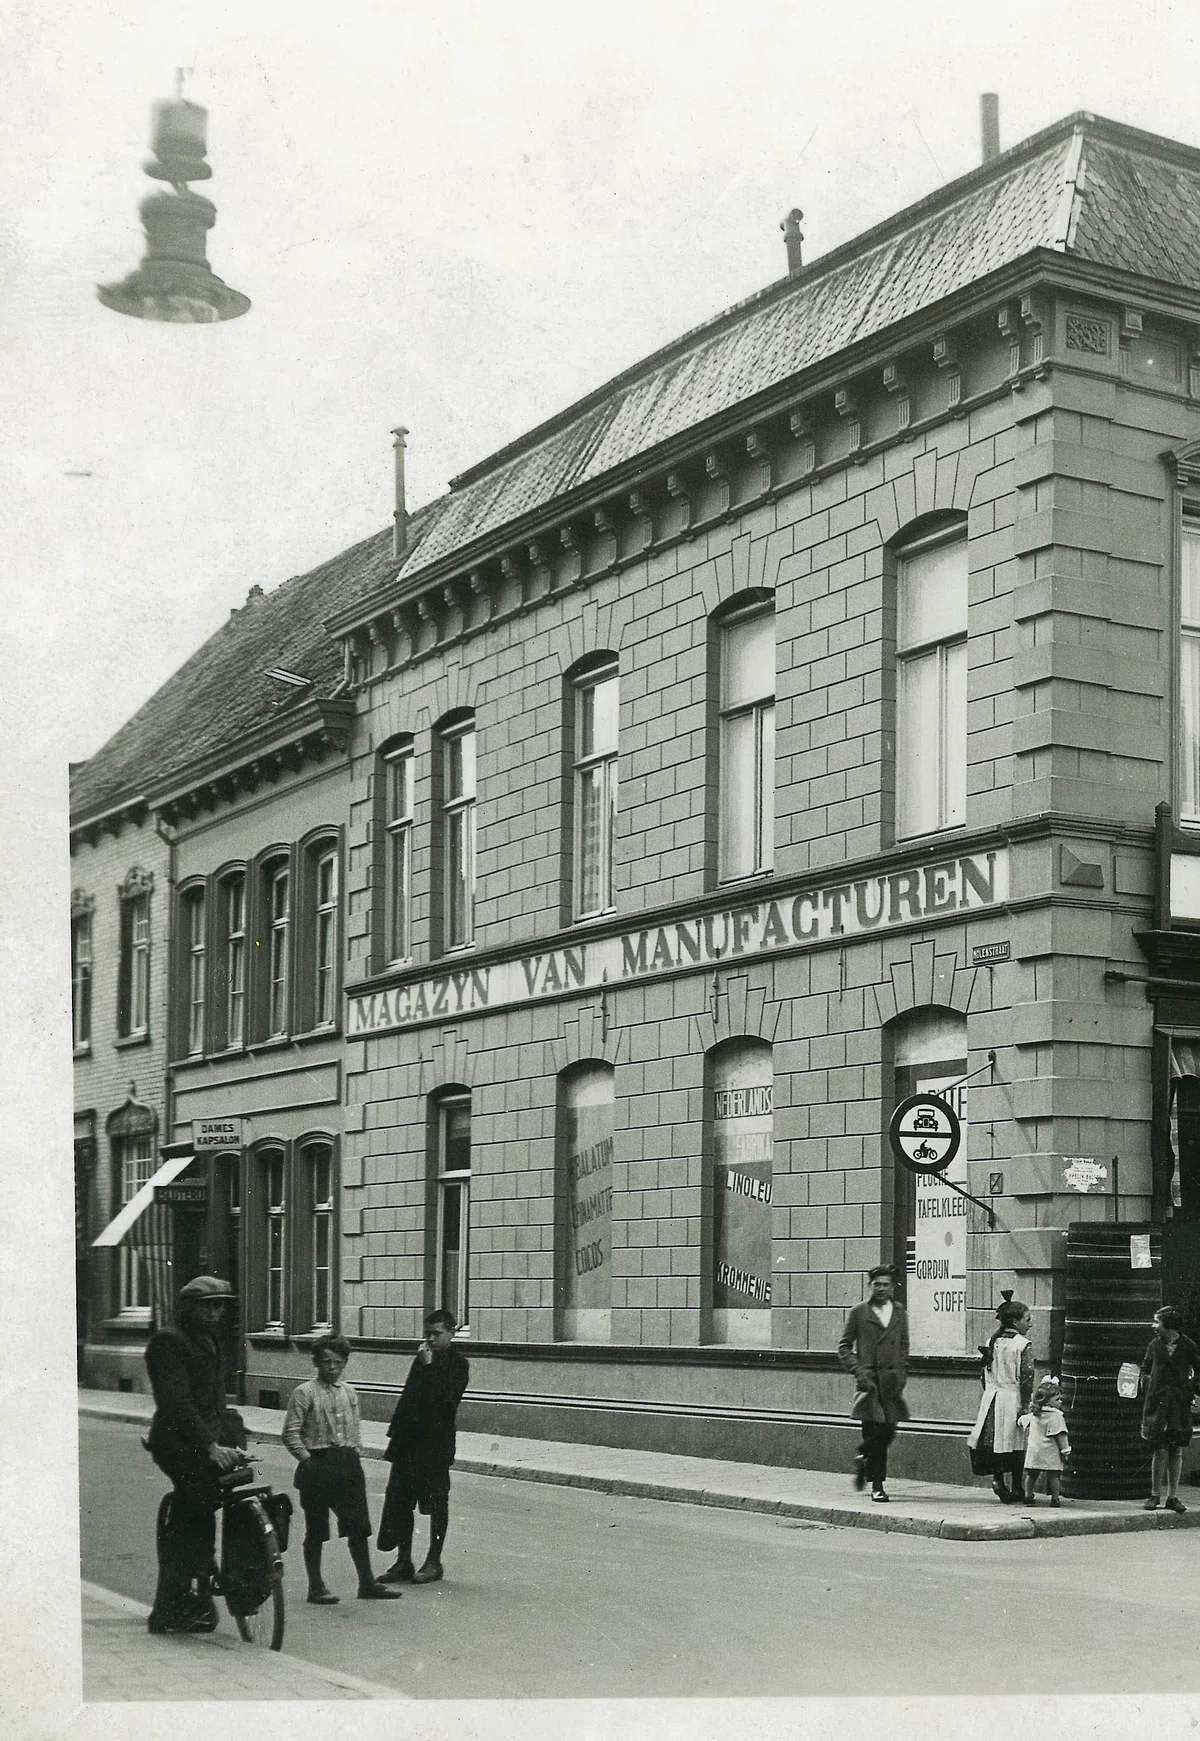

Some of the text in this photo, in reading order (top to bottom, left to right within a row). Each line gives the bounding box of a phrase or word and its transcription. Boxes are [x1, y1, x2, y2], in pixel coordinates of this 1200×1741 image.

[356, 853, 996, 1031] MAGAZYN VAN MANUFACTUREN
[714, 1087, 773, 1119] NEDERLANDS
[201, 1123, 234, 1134] DAMES
[196, 1135, 240, 1145] KAPSALON
